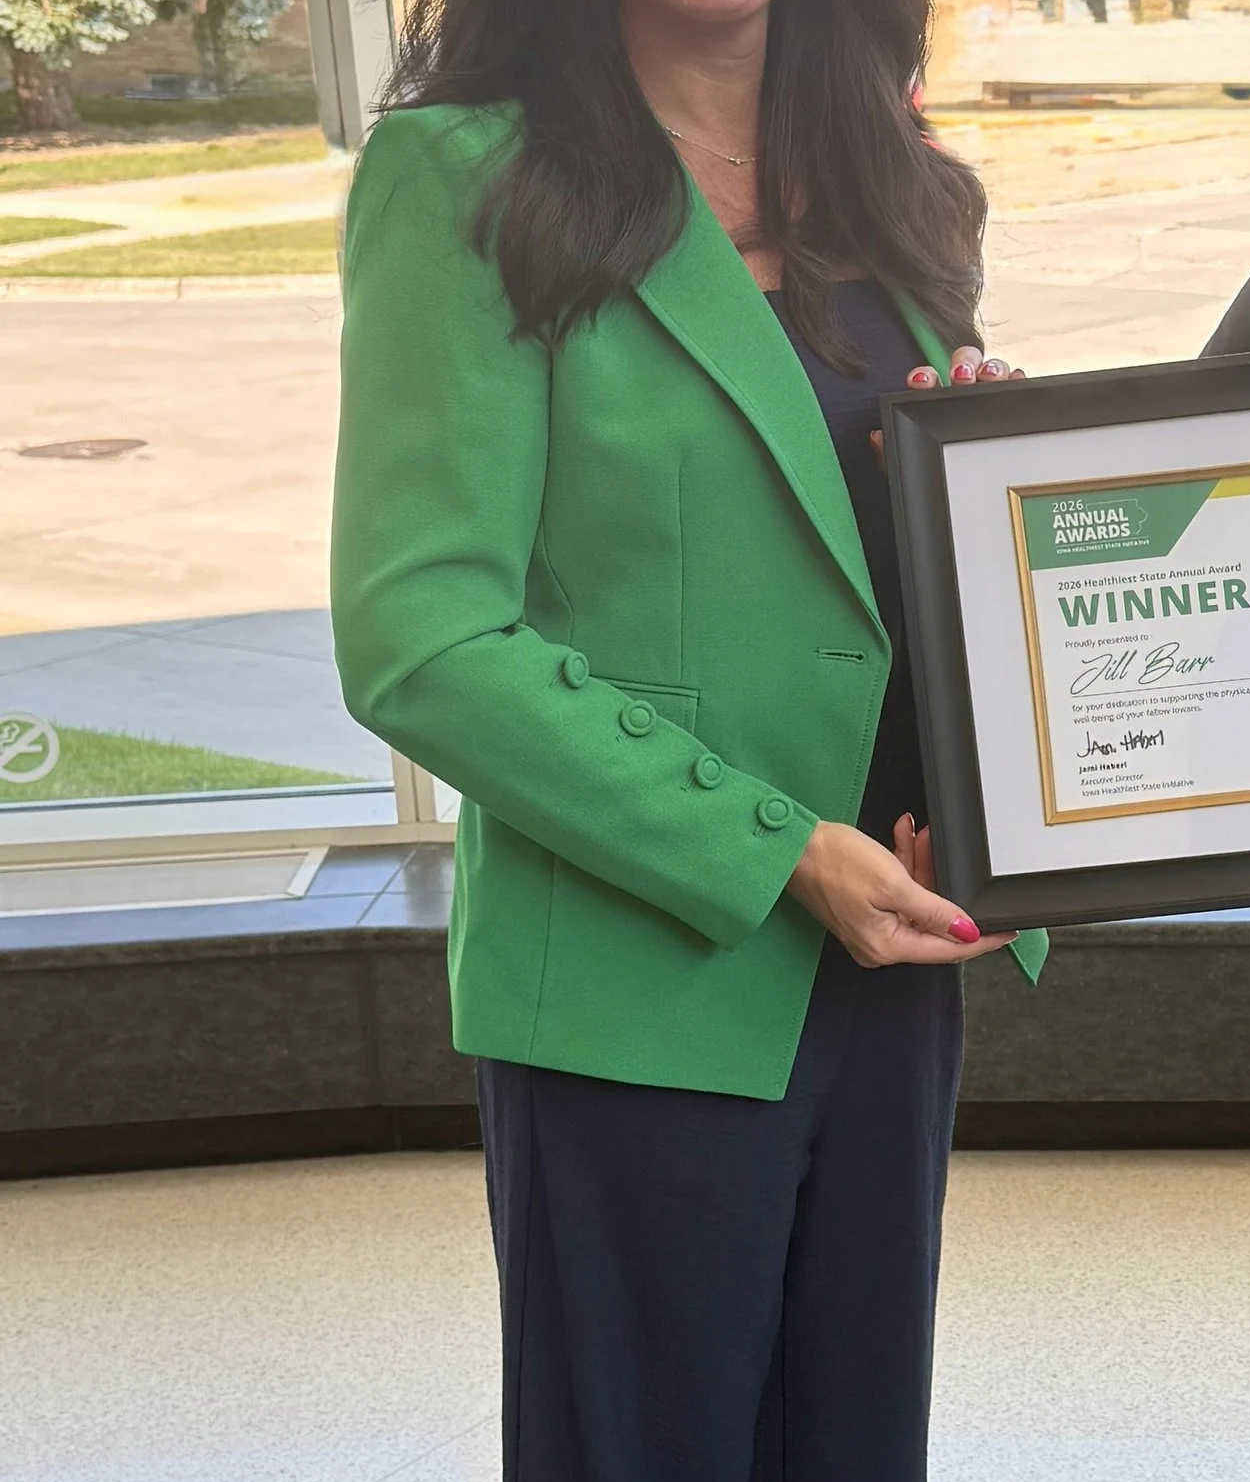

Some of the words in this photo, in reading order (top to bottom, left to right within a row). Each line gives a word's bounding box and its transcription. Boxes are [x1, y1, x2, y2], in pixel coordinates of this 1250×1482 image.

[1052, 499, 1084, 513] 2026
[1053, 507, 1129, 529] ANNUAL
[1055, 522, 1131, 544] AWARDS
[1058, 581, 1082, 591] 2026
[1084, 574, 1137, 588] Healthiest
[1140, 571, 1167, 582] State
[1169, 566, 1206, 579] Annual
[1208, 562, 1242, 575] Award
[1058, 578, 1250, 628] WINNER
[1065, 638, 1096, 649] Proudly
[1098, 634, 1139, 647] presented
[1070, 649, 1138, 695] Jill
[1138, 642, 1216, 685] Barr
